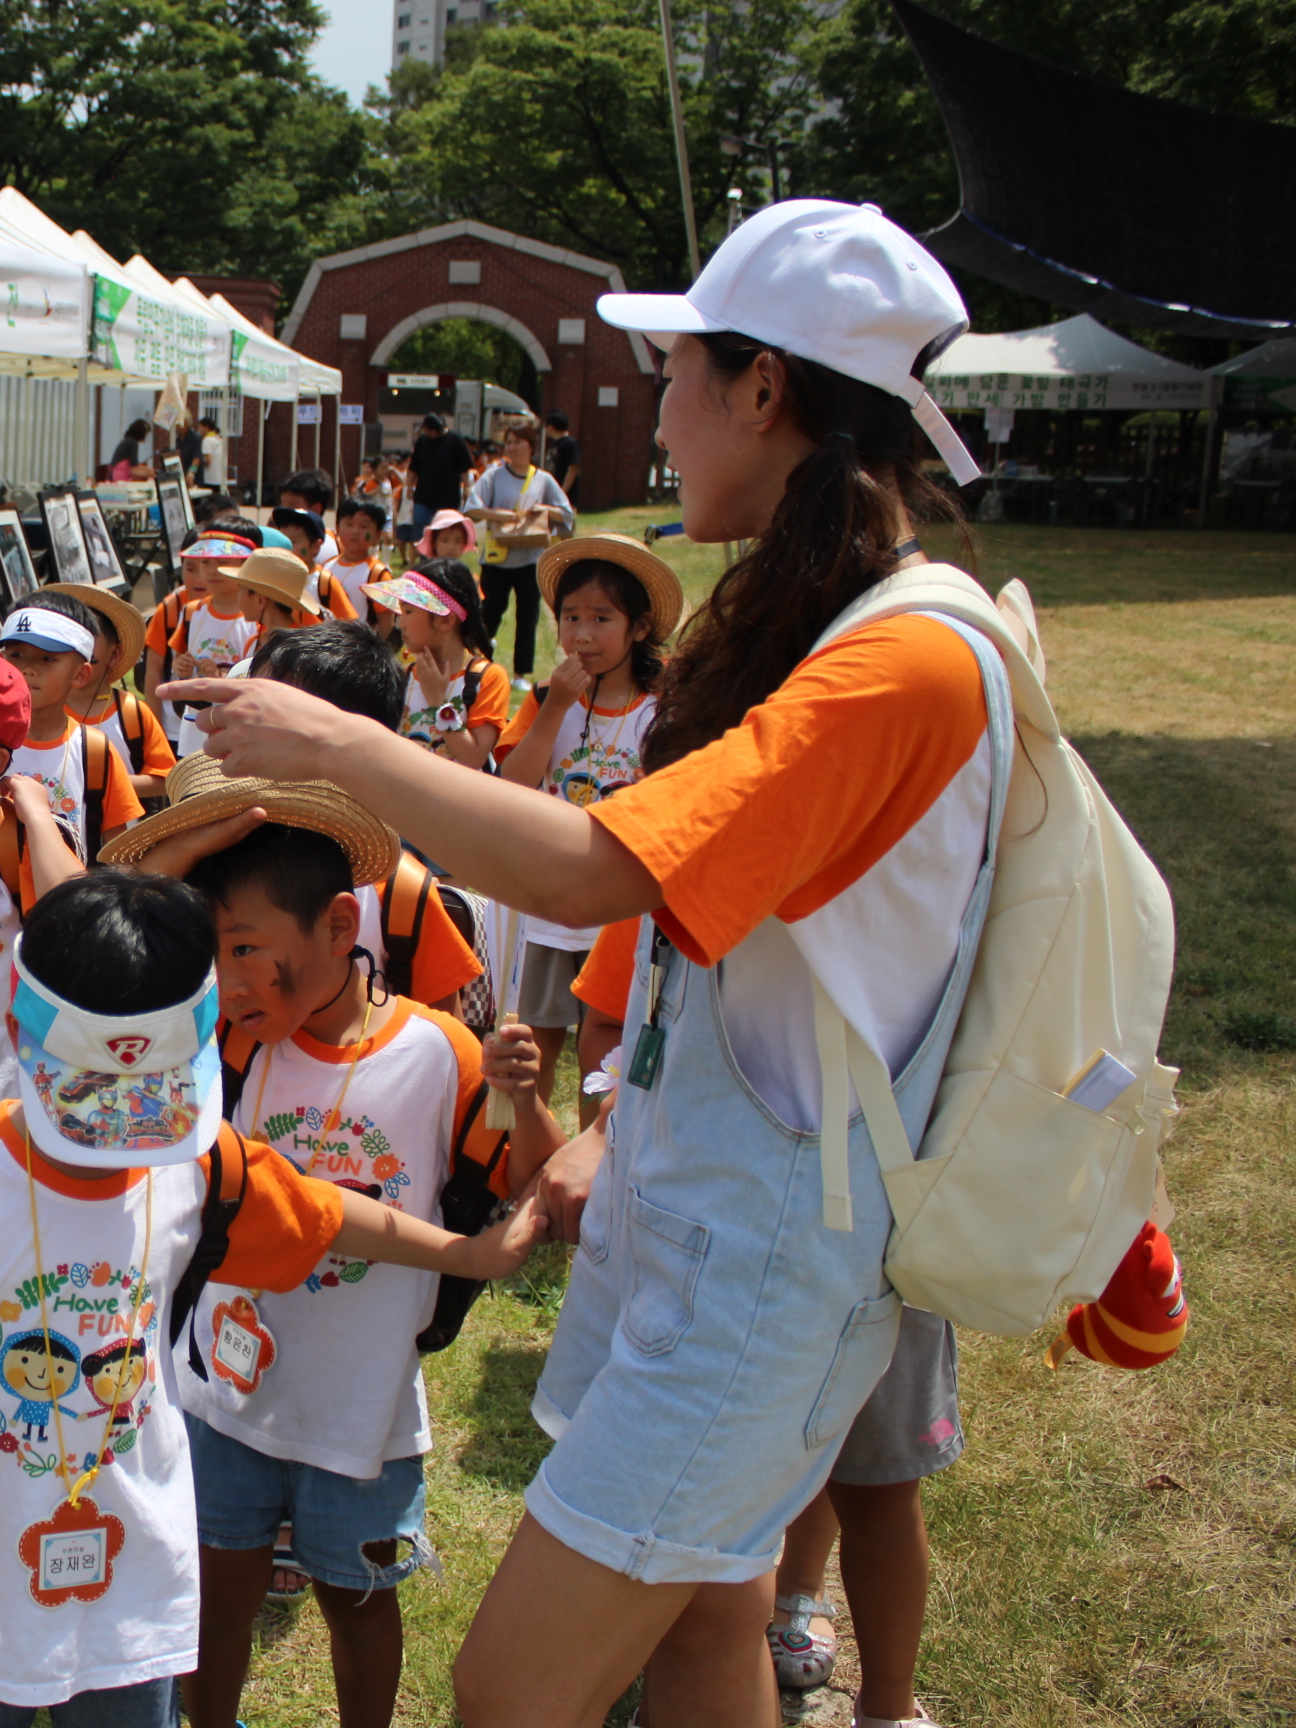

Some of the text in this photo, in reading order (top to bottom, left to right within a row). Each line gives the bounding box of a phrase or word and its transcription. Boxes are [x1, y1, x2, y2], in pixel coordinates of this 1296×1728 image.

[16, 613, 32, 632] LA
[599, 767, 628, 779] FUN
[293, 1133, 350, 1157] Have
[311, 1152, 363, 1177] FUN
[53, 1293, 119, 1315] Have
[78, 1313, 132, 1337] FUN
[223, 1330, 252, 1359] 황윤찬
[50, 1553, 96, 1574] 장재완
